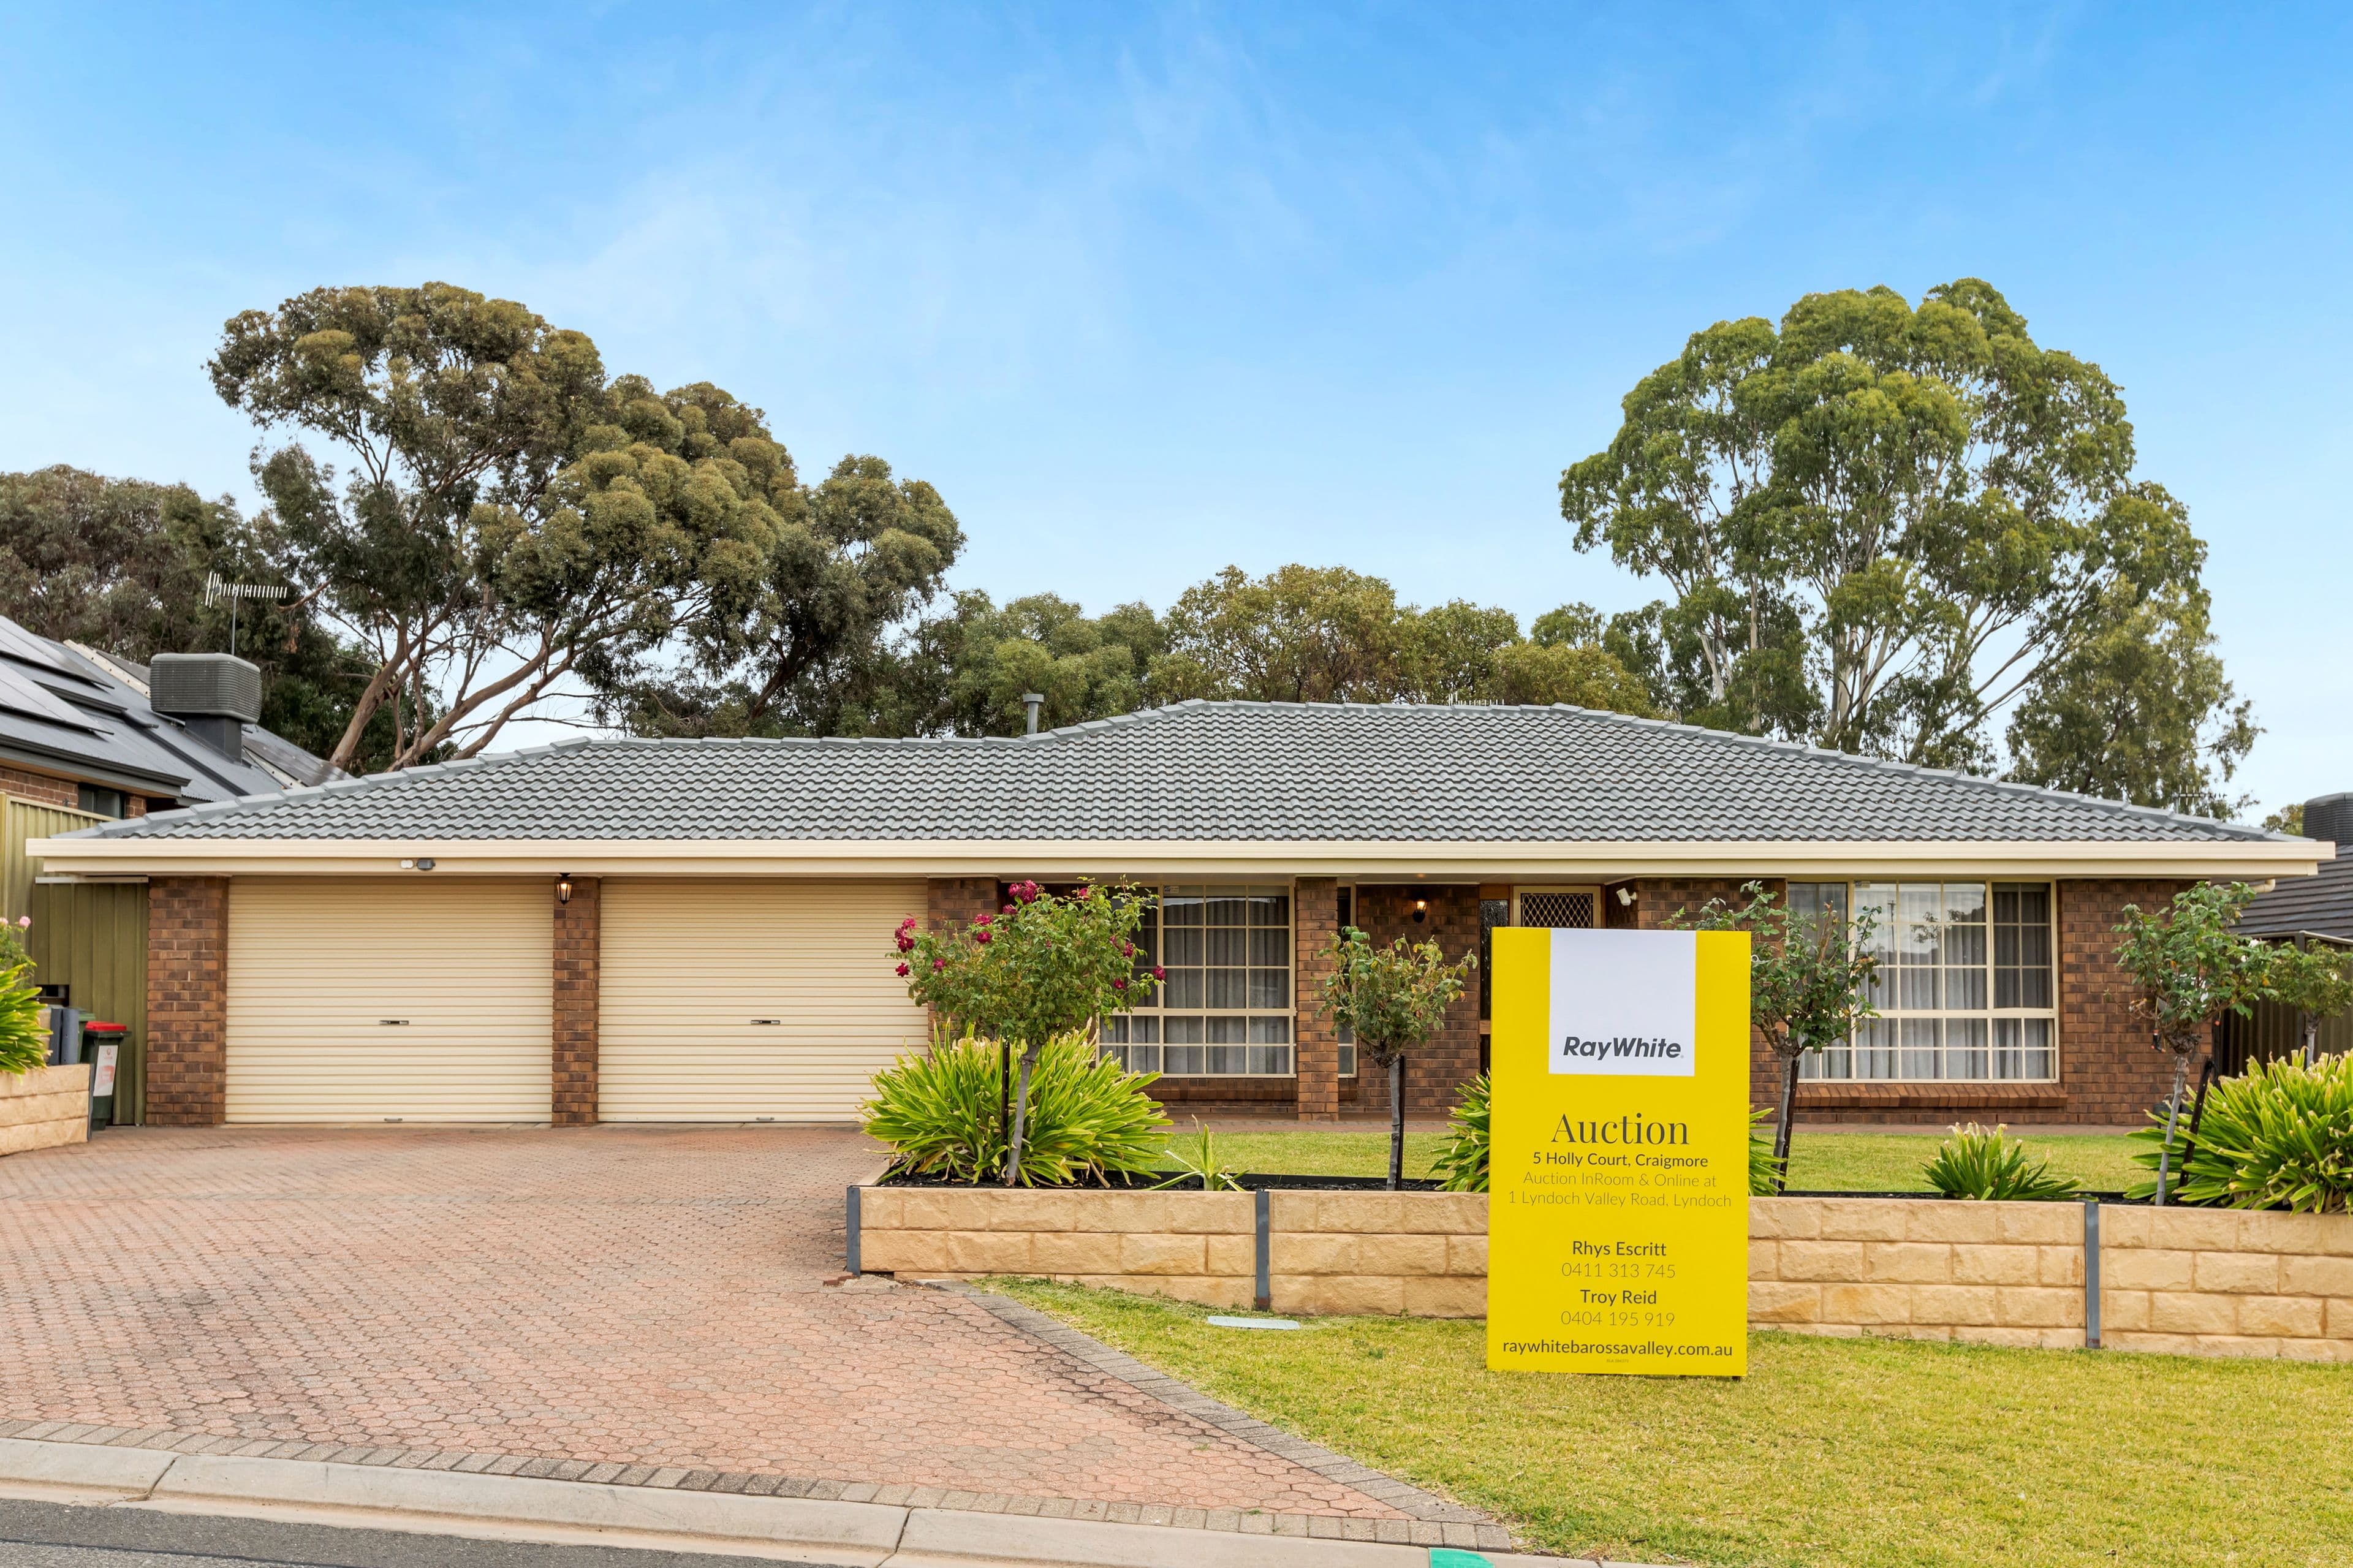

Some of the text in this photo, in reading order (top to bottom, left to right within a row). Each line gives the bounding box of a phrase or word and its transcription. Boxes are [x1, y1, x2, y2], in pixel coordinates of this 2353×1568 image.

[1563, 1036, 1681, 1061] RayWhite
[1551, 1113, 1689, 1145] Auction
[1533, 1152, 1708, 1169] 5 Holly Court, Craigmore
[1523, 1172, 1717, 1187] Auction InRoom & Online at
[1509, 1191, 1515, 1203] 1
[1523, 1191, 1579, 1206] Lyndoch
[1585, 1192, 1626, 1207] Valley
[1674, 1194, 1730, 1209] Lyndoch
[1573, 1241, 1667, 1258] Rhys Escritt
[1562, 1263, 1675, 1278] 0411 313 745
[1580, 1289, 1656, 1306] Troy Reid
[1561, 1311, 1675, 1327] 0404 195 919
[1503, 1339, 1732, 1358] raywhitebarossavalley.com.au
